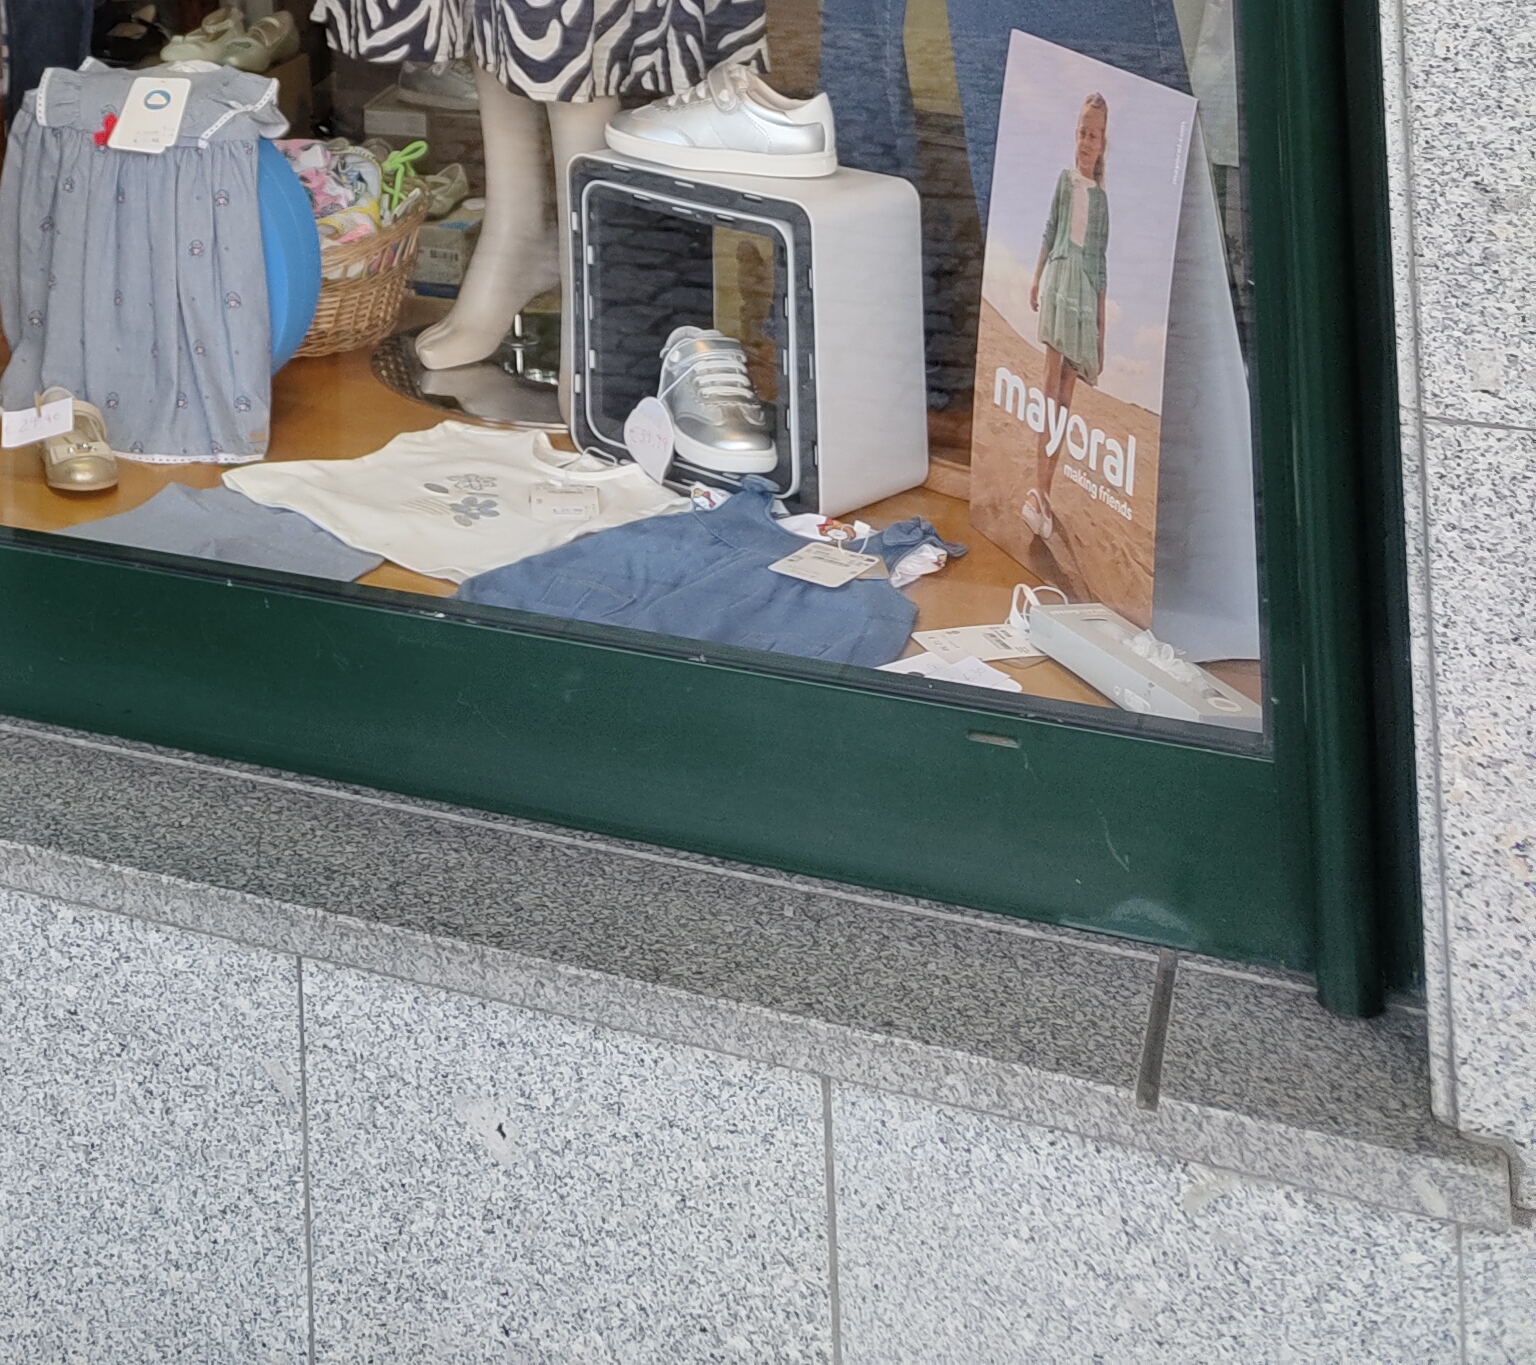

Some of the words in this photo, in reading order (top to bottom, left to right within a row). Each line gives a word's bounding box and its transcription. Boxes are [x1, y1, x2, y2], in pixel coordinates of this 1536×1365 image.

[994, 366, 1136, 498] mayoral
[1063, 464, 1098, 500] making
[1098, 485, 1133, 521] friends
